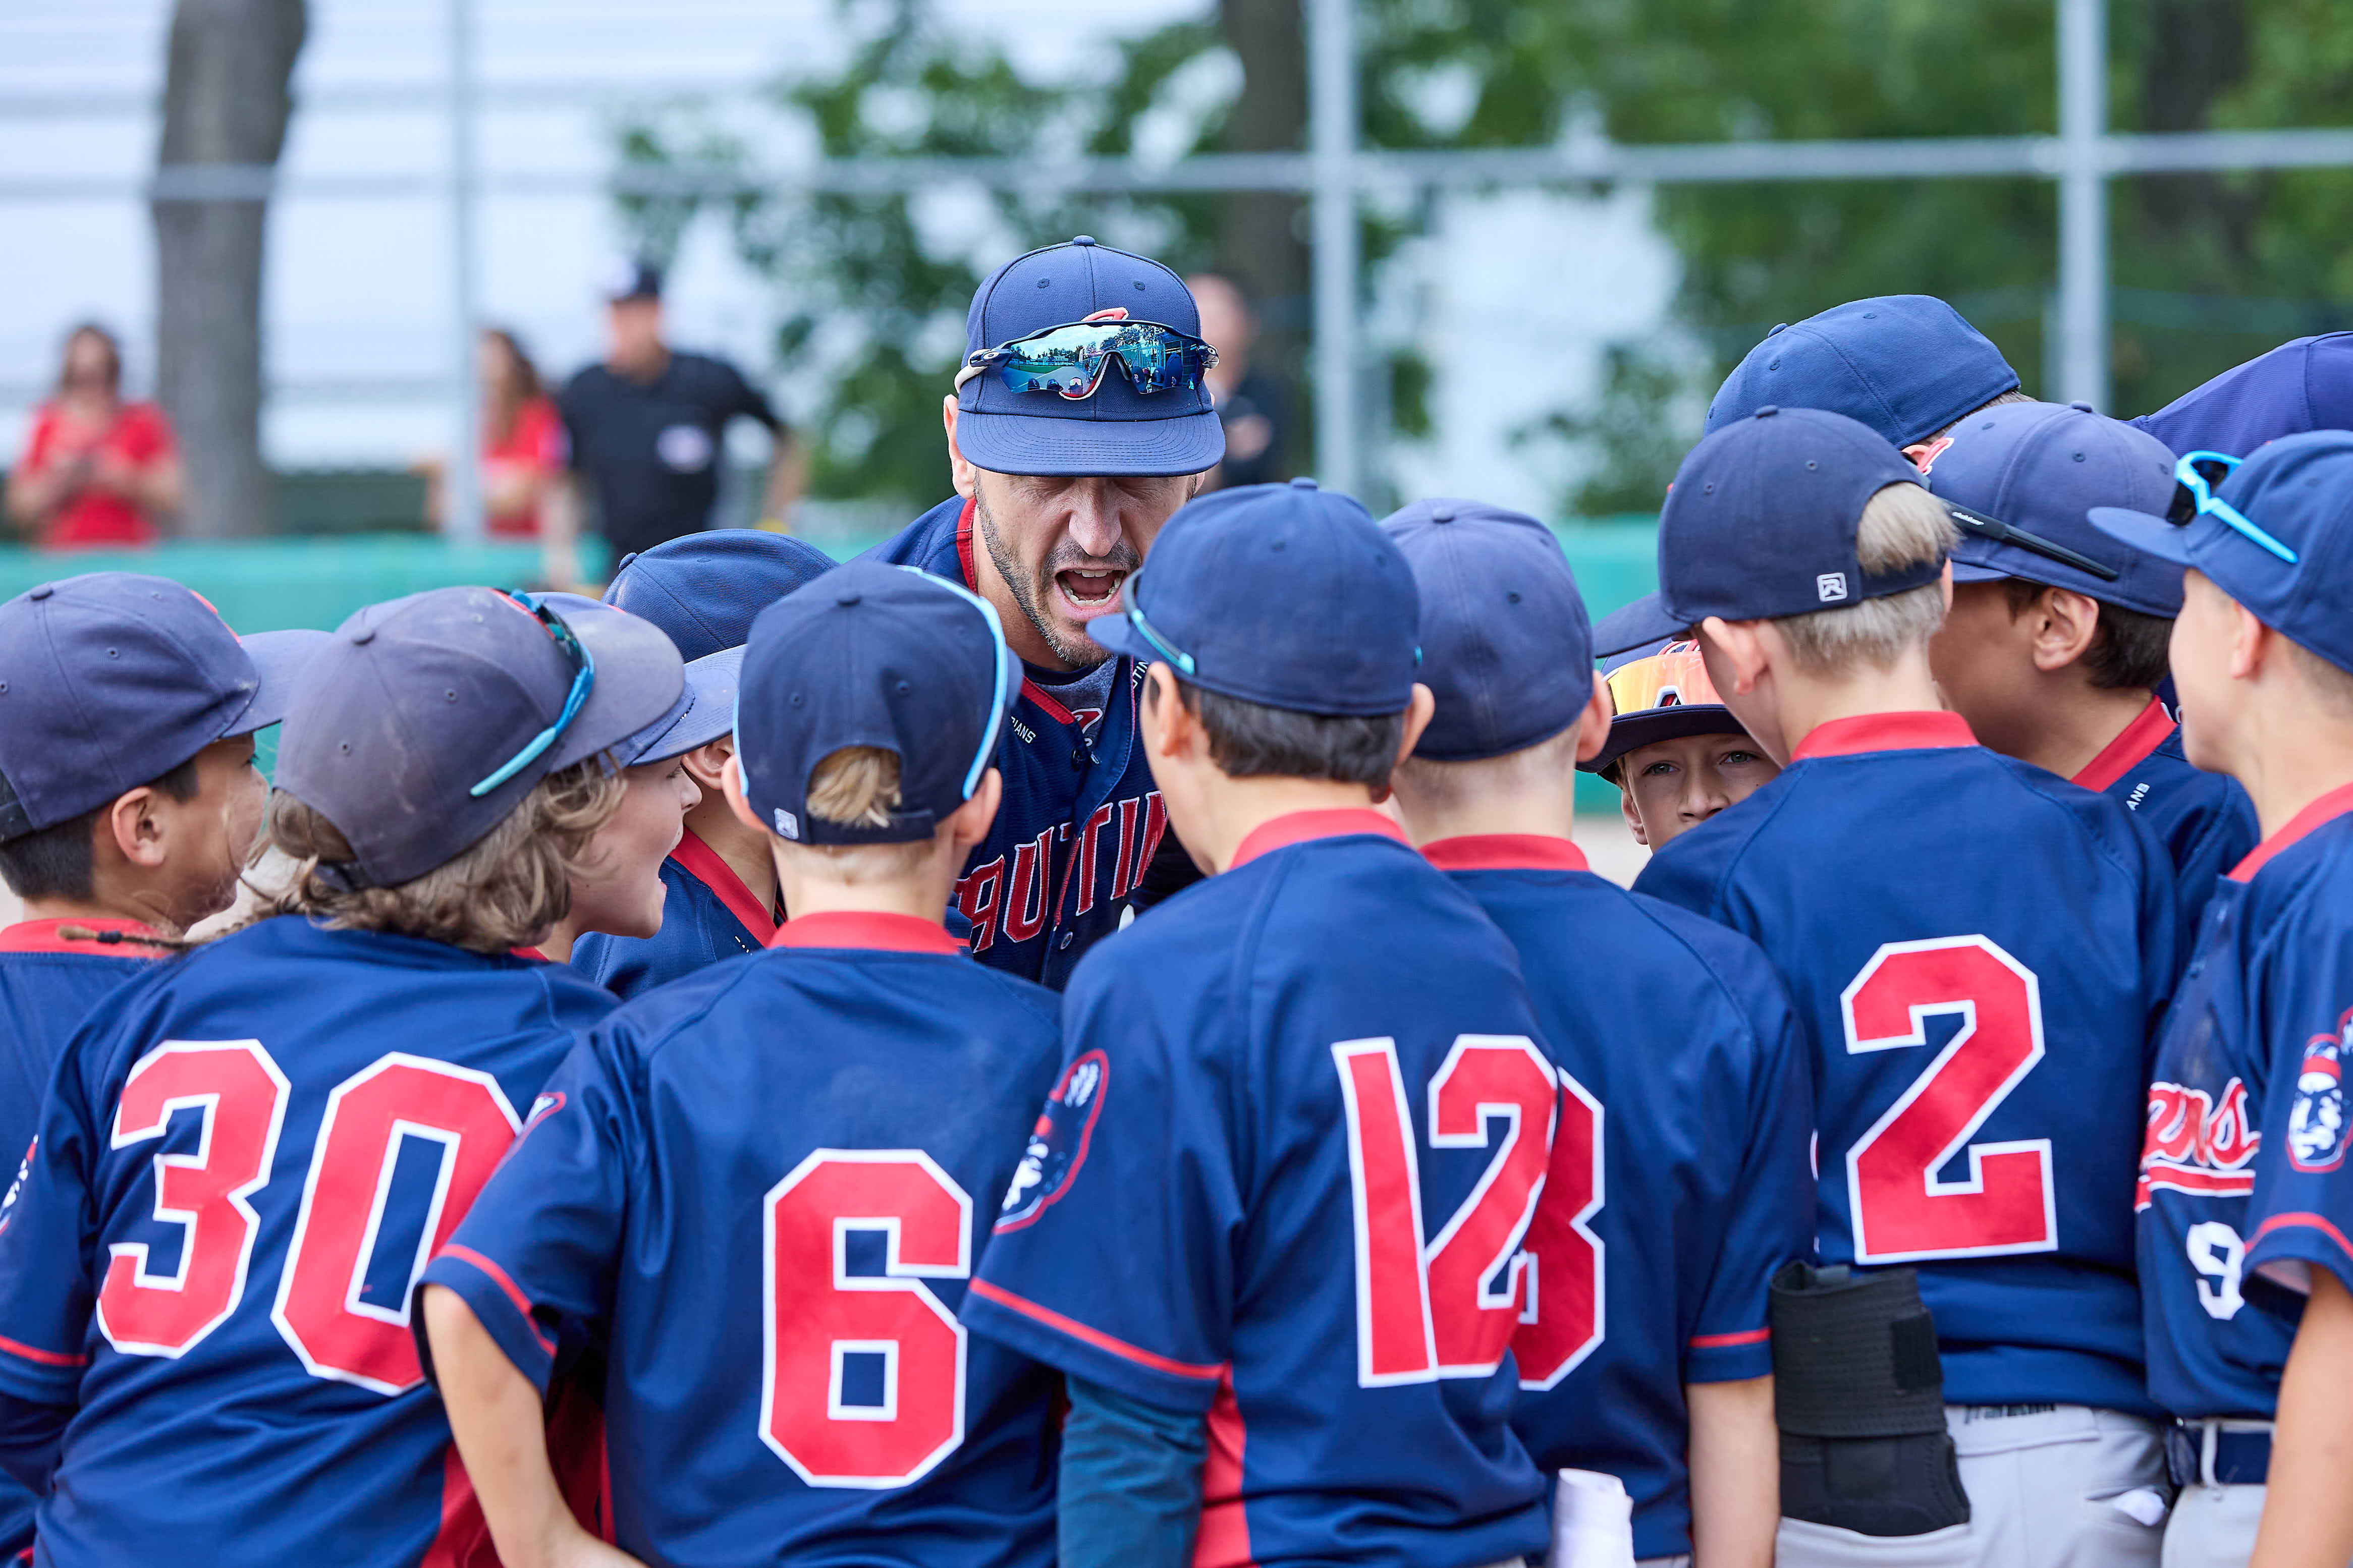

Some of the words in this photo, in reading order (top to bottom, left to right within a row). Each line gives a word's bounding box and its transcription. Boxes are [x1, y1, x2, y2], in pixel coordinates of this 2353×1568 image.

[97, 1039, 523, 1395] 30
[1331, 1034, 1557, 1388] 12
[1840, 934, 2058, 1265] 2
[758, 1149, 972, 1488] 6
[2186, 1221, 2245, 1320] 9
